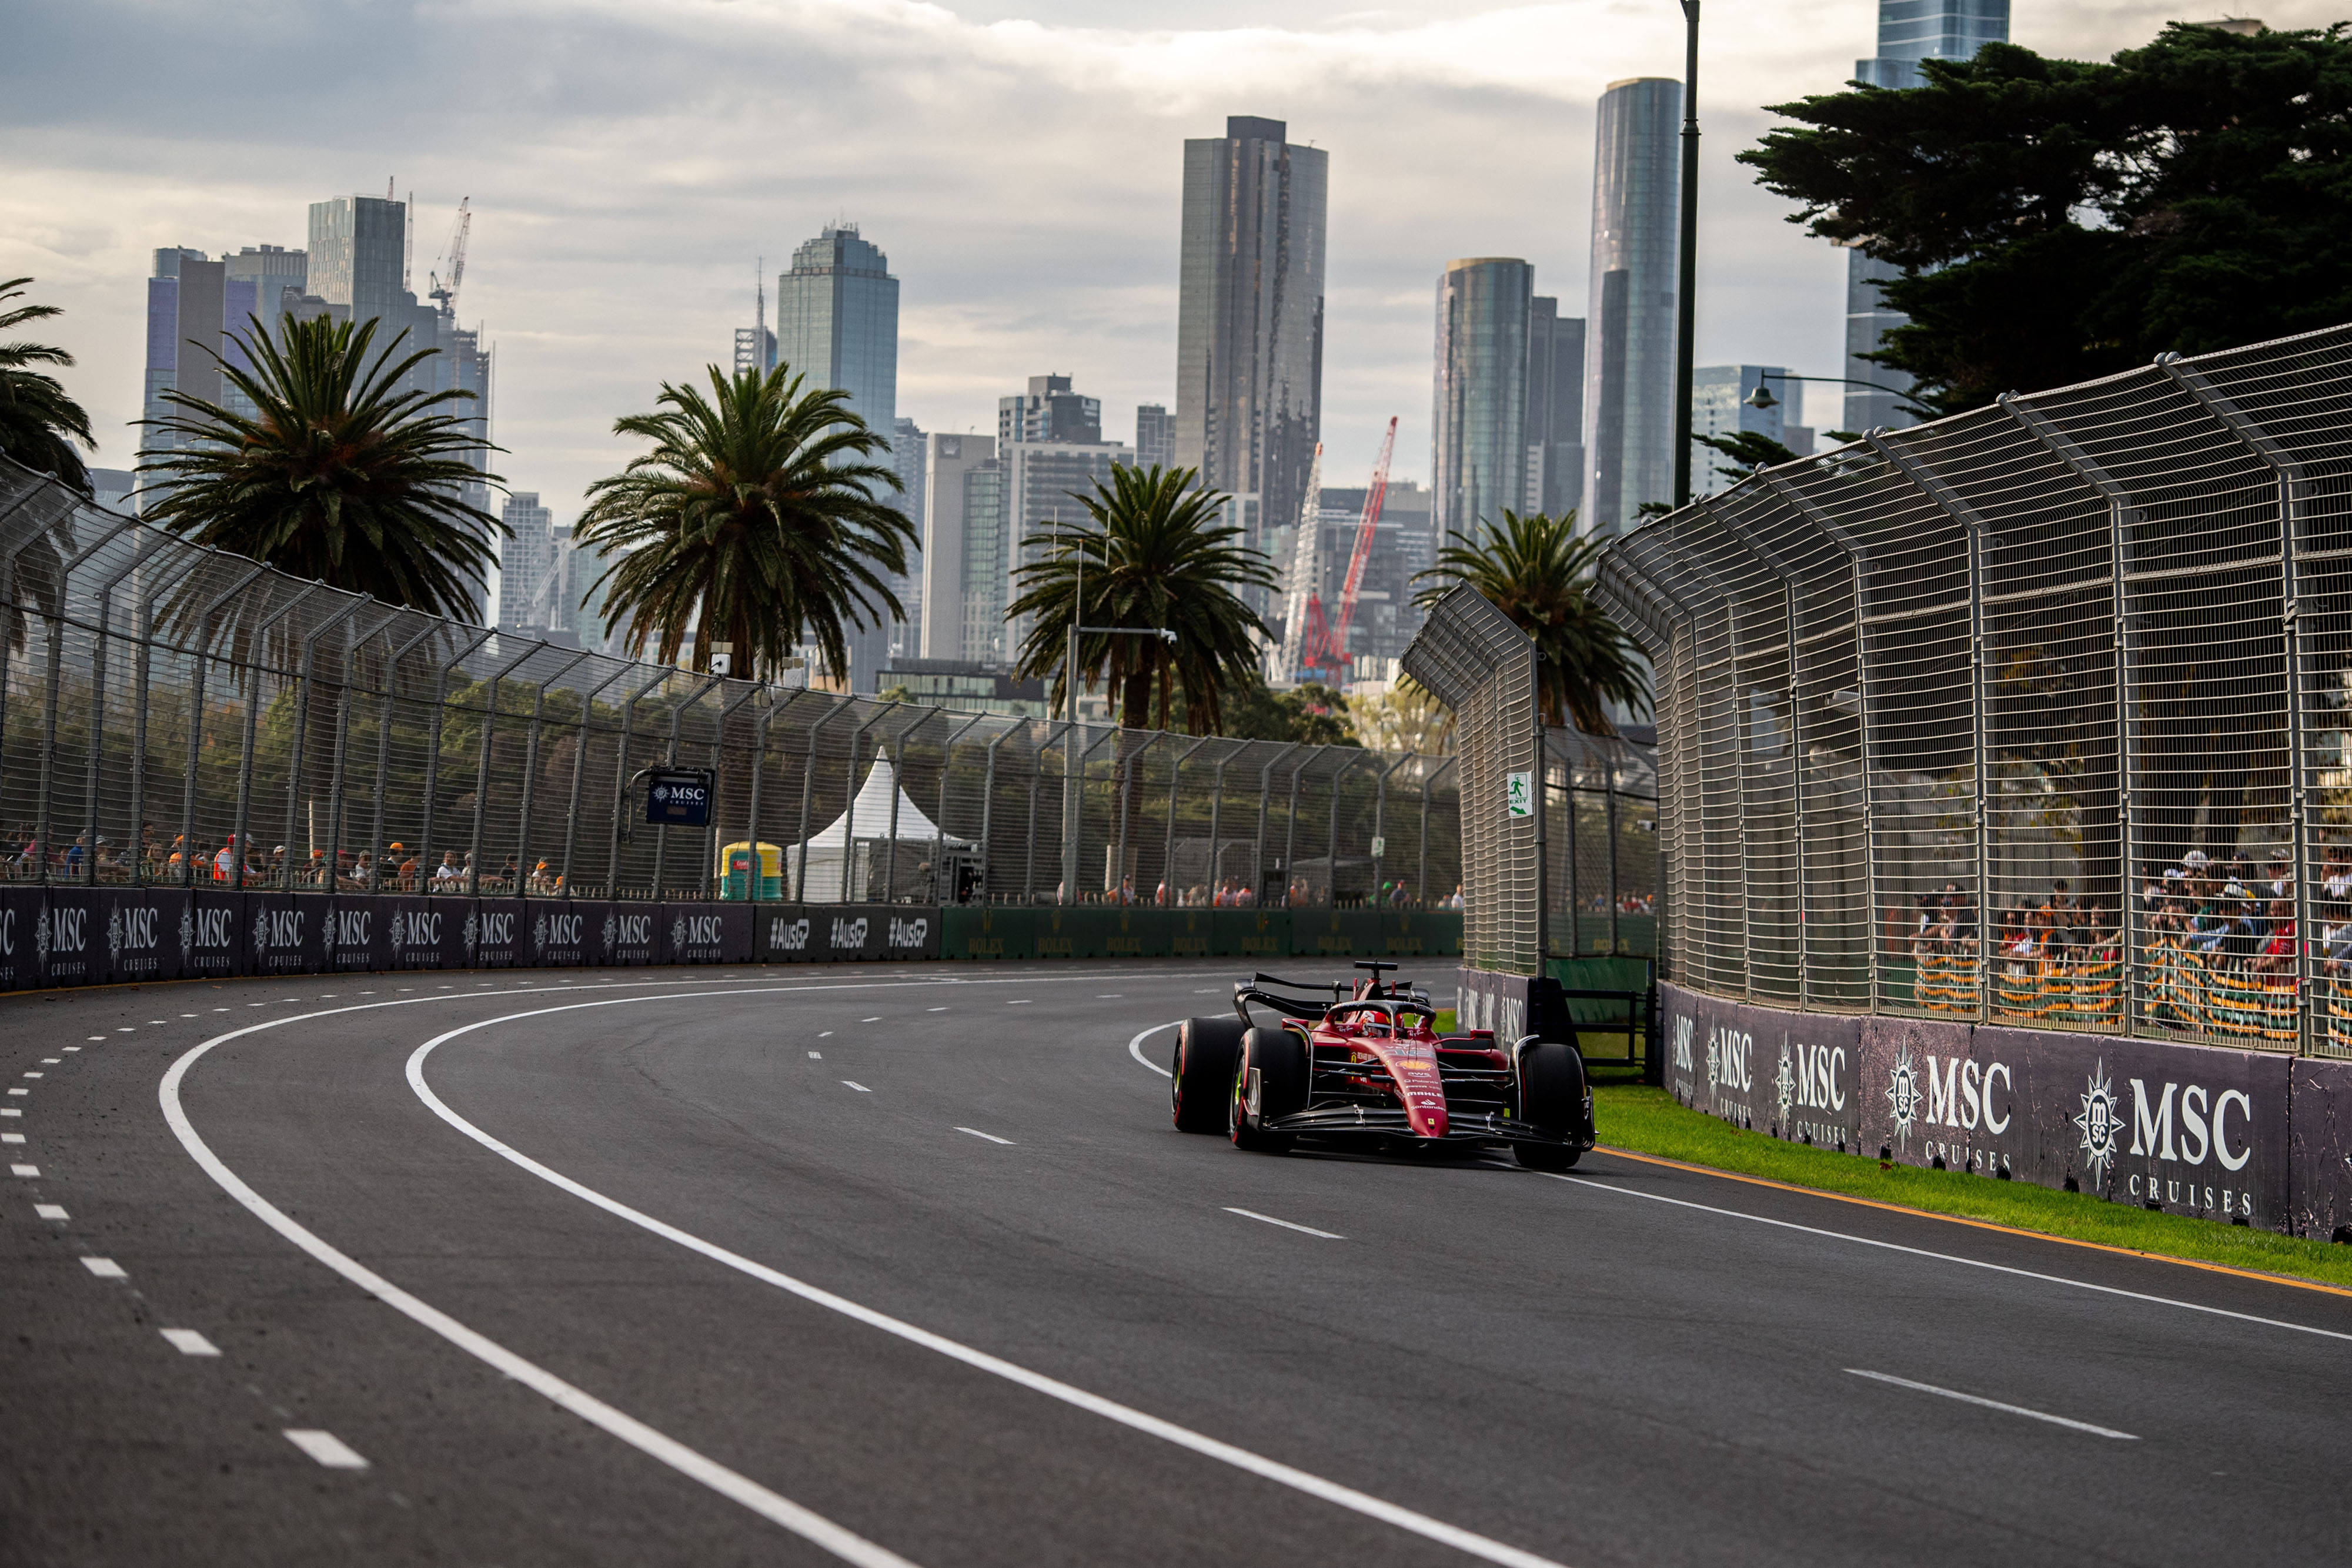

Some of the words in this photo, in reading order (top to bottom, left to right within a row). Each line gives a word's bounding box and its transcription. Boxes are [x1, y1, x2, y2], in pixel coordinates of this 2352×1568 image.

[670, 787, 704, 800] MSC
[53, 908, 86, 951] MSC
[125, 908, 158, 948] MSC
[195, 908, 231, 947] MSC
[270, 911, 304, 947] MSC
[338, 911, 371, 945] MSC
[407, 912, 441, 945] MSC
[481, 913, 514, 944] MSC
[549, 915, 582, 944] MSC
[619, 915, 650, 944] MSC
[689, 916, 721, 944] MSC
[406, 952, 439, 962] CRUISES
[480, 951, 512, 961] CRUISES
[548, 951, 580, 961] CRUISES
[617, 950, 649, 959] CRUISES
[968, 938, 1004, 953] ROLEX
[1038, 937, 1073, 952] ROLEX
[1107, 937, 1141, 952] ROLEX
[1173, 937, 1207, 952] ROLEX
[1387, 937, 1422, 950] ROLEX
[52, 962, 85, 976] CRUISES
[195, 957, 229, 967] CRUISES
[337, 953, 369, 964] CRUISES
[1676, 1014, 1693, 1072] MSC
[1720, 1028, 1752, 1092] MSC
[1797, 1044, 1846, 1111] MSC
[1926, 1055, 2010, 1134] MSC
[1797, 1121, 1846, 1145] CRUISES
[2130, 1078, 2251, 1171] MSC
[1925, 1141, 2010, 1173] CRUISES
[2129, 1174, 2251, 1216] CRUISES
